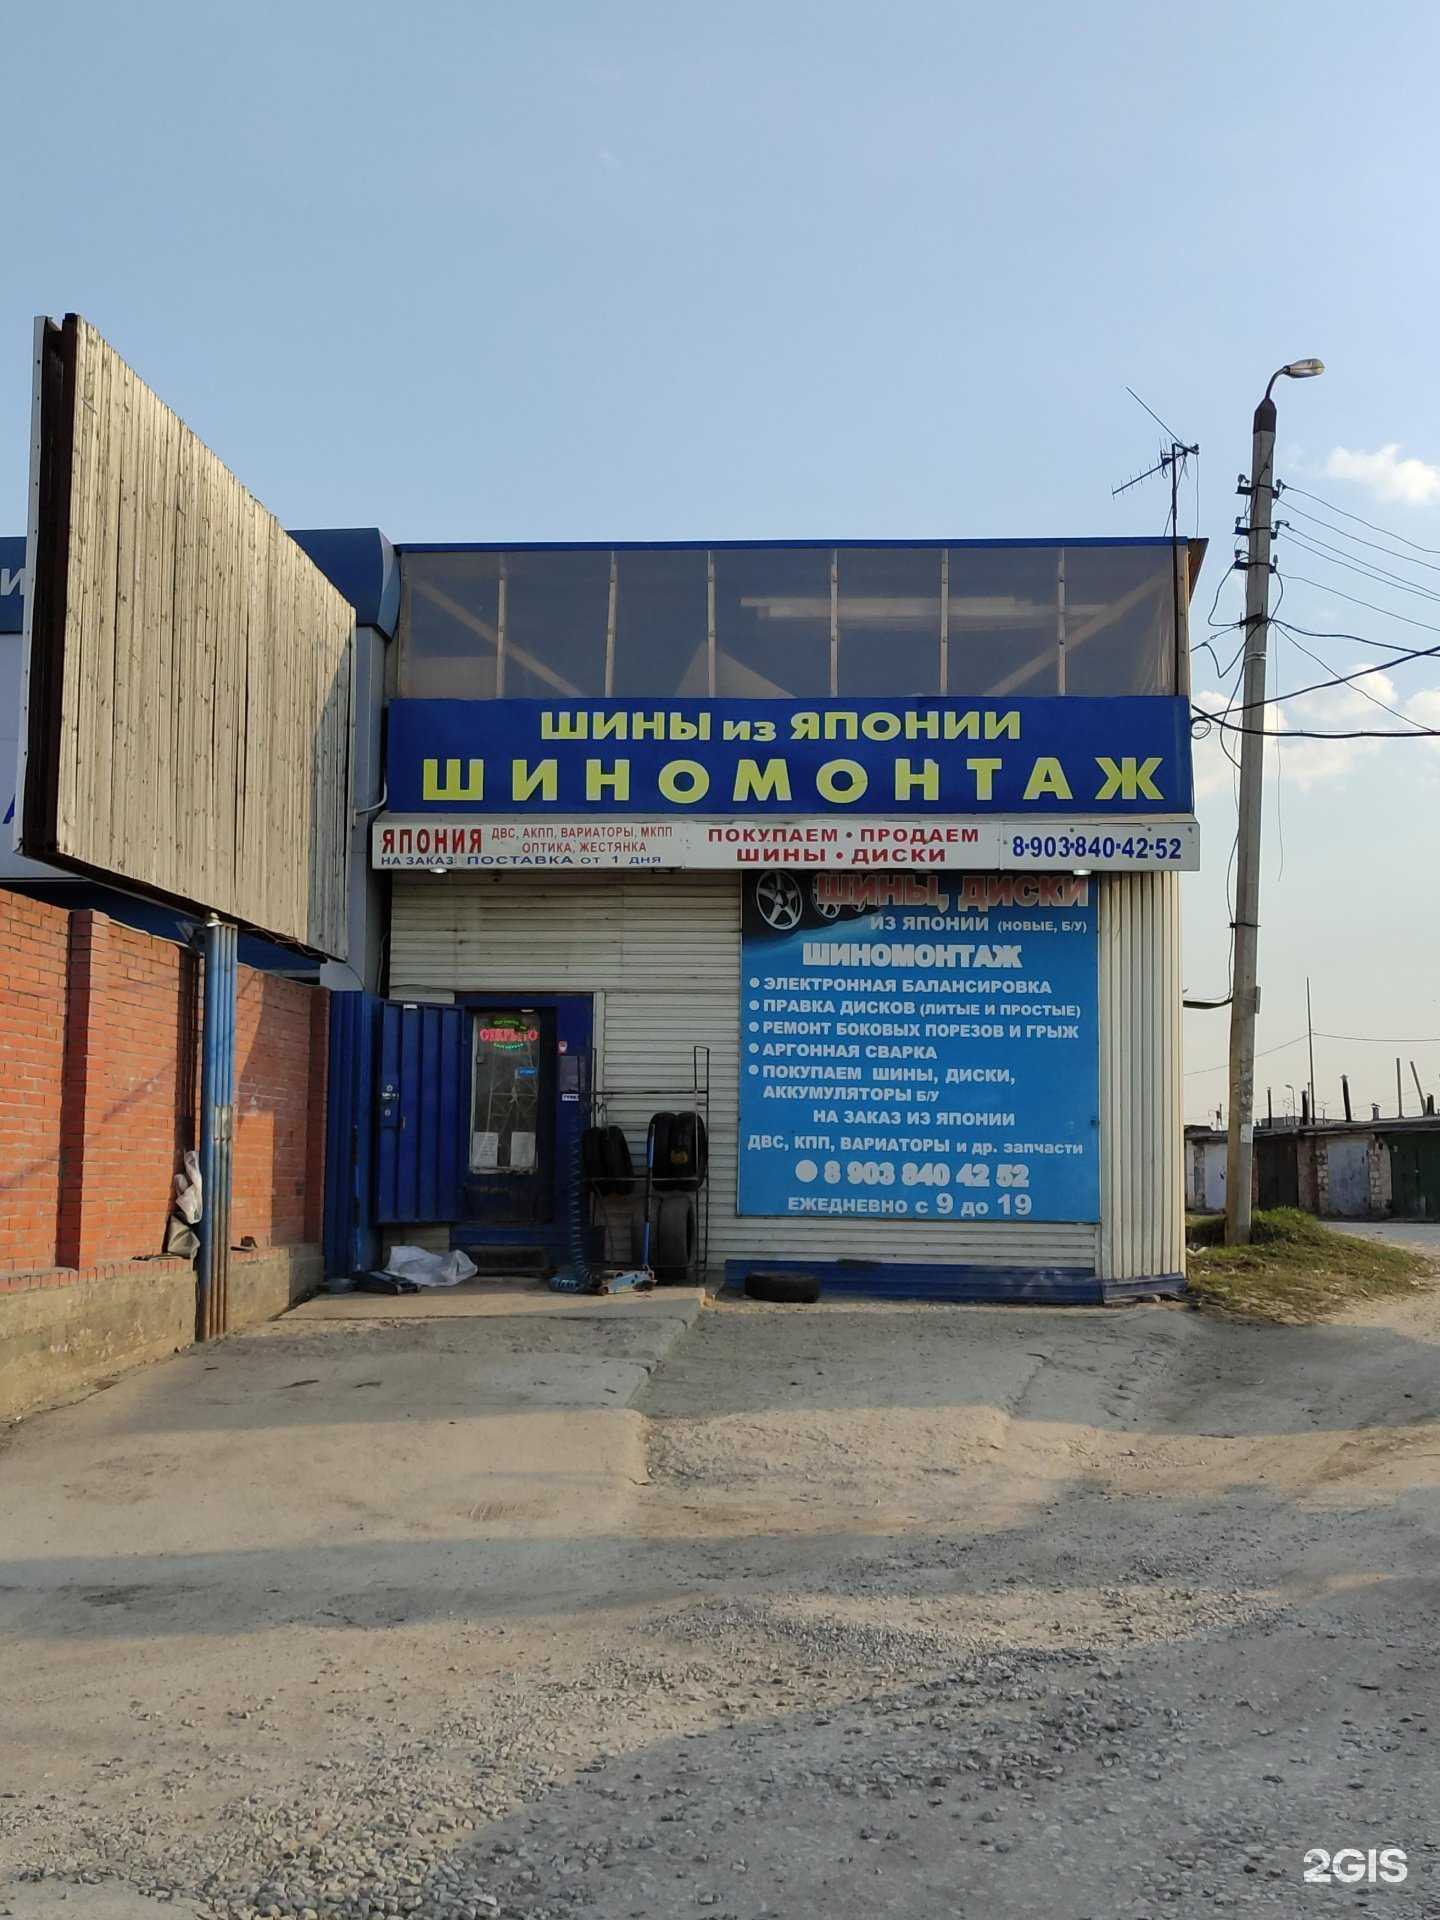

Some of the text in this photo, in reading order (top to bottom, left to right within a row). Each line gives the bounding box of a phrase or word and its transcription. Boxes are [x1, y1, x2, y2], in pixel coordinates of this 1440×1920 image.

[541, 711, 1021, 741] ШИНЫ из ЯПОНИИ
[423, 757, 1164, 803] ШИНОМОНТАЖ
[382, 829, 482, 854] ЯПОНИЯ
[492, 827, 672, 840] ДВС, АКПП, ВАРИАТОРЫ, МКПП
[708, 828, 979, 845] ПОКУПАЕМ ПРОДАЕМ
[522, 841, 646, 854] ОПТИКА, ЖЕСТЯНКА
[381, 856, 401, 865] НА
[467, 856, 573, 864] ПОСТАВКА
[612, 856, 618, 864] 1
[737, 849, 946, 864] ШИНЫ ДИСКИ
[816, 873, 1088, 913] ШИНЫ, ДИСКИ
[871, 917, 1087, 933] ИЗ ЯПОНИИ (НОВЫЕ, Б/У)
[803, 943, 1023, 967] ШИНОМОНТАЖ
[763, 978, 1052, 994] ЭЛЕКТРОННАЯ БАЛАНСИРОВКА
[763, 1000, 1081, 1018] ПРАВКА ДИСКОВ (ЛИТЫЕ И ПРОСТЫЕ)
[763, 1022, 1079, 1039] РЕМОНТ БОКОВЫХ ПОРЕЗОВ И ГРЫЖ
[762, 1044, 937, 1059] АРГОННАЯ СВАРКА
[763, 1065, 1016, 1085] ПОКУПАЕМ ШИНЫ, ДИСКИ,
[763, 1087, 939, 1102] АККУМУЛЯТОРЫ Б/У
[814, 1111, 1015, 1126] НА ЗАКАЗ ИЗ ЯПОНИИ
[747, 1135, 788, 1151] ДВС,
[795, 1136, 835, 1151] КПП,
[840, 1137, 950, 1153] ВАРИАТОРЫ
[1003, 1143, 1083, 1154] запчасти
[824, 1161, 1029, 1187] 8 903 840 42 52
[788, 1197, 908, 1213] ЕЖЕДНЕВНО
[936, 1192, 953, 1214] 9
[997, 1194, 1031, 1215] 19
